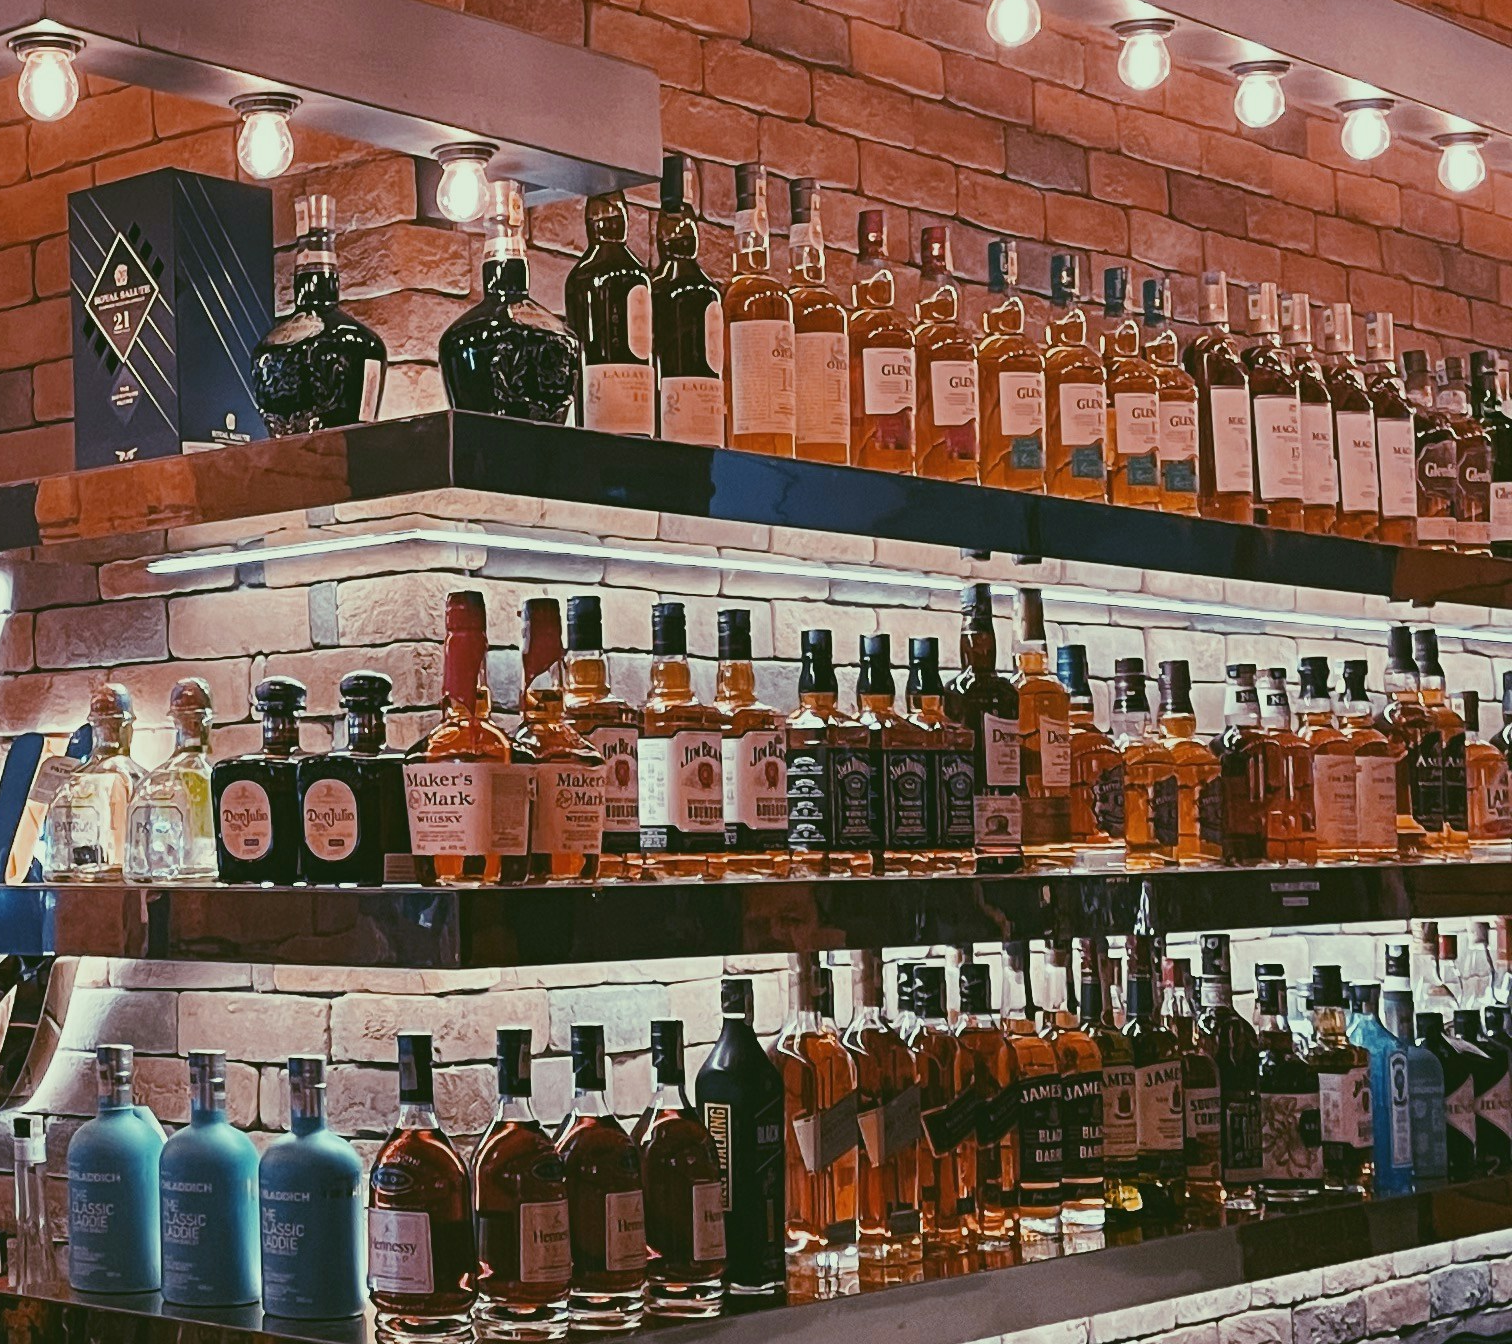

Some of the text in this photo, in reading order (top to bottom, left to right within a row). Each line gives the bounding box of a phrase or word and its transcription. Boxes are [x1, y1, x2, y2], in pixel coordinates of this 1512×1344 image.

[94, 291, 119, 306] ROYAL
[119, 284, 151, 300] SALUTE
[113, 310, 130, 331] 21
[406, 772, 473, 787] Maker's
[423, 791, 476, 806] Mark
[222, 808, 268, 828] Don Julio
[306, 807, 355, 827] Don Julio
[416, 814, 463, 823] WHISKY
